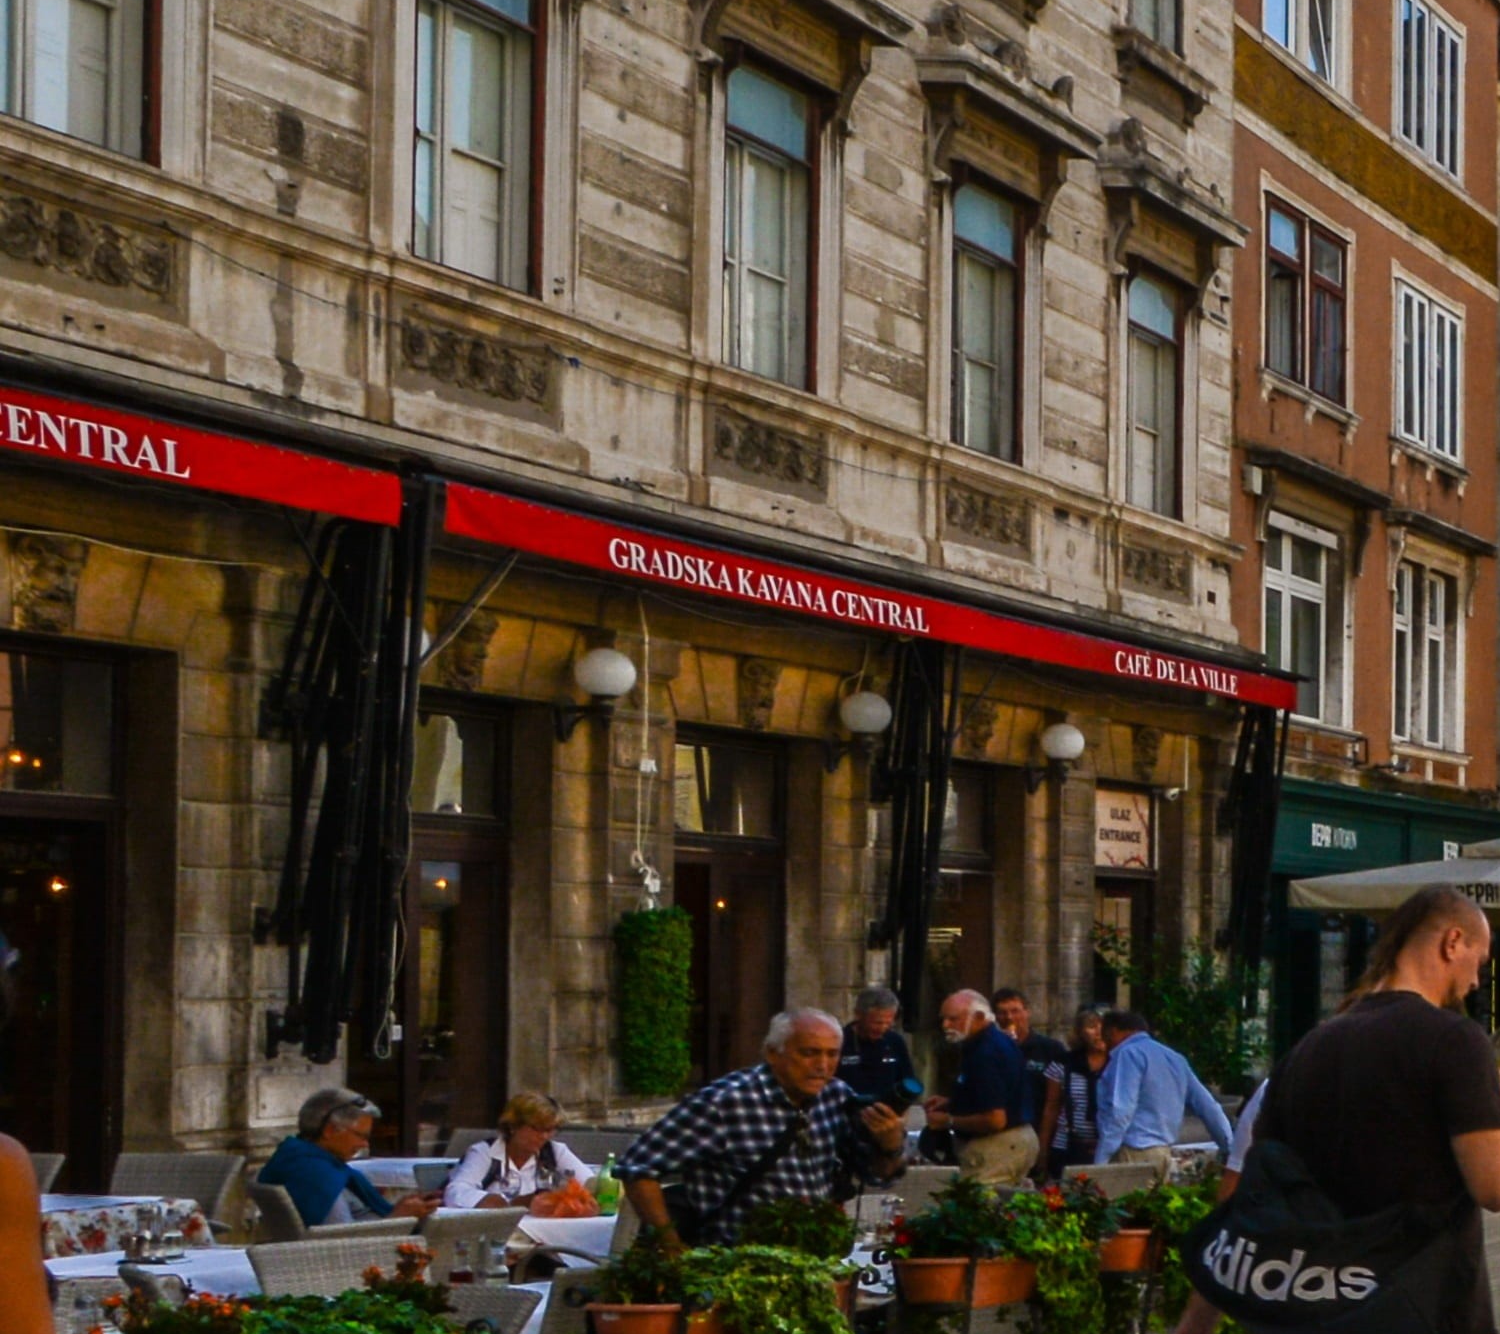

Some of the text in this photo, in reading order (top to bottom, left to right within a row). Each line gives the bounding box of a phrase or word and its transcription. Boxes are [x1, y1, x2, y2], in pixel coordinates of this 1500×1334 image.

[608, 538, 930, 634] GRADSKA KAVANA CENTRAL
[1156, 658, 1177, 682] DE
[1179, 662, 1198, 687] LA
[1199, 666, 1238, 696] VILLE
[1110, 808, 1131, 821] ULAZ
[1099, 828, 1141, 843] ENTRANCE
